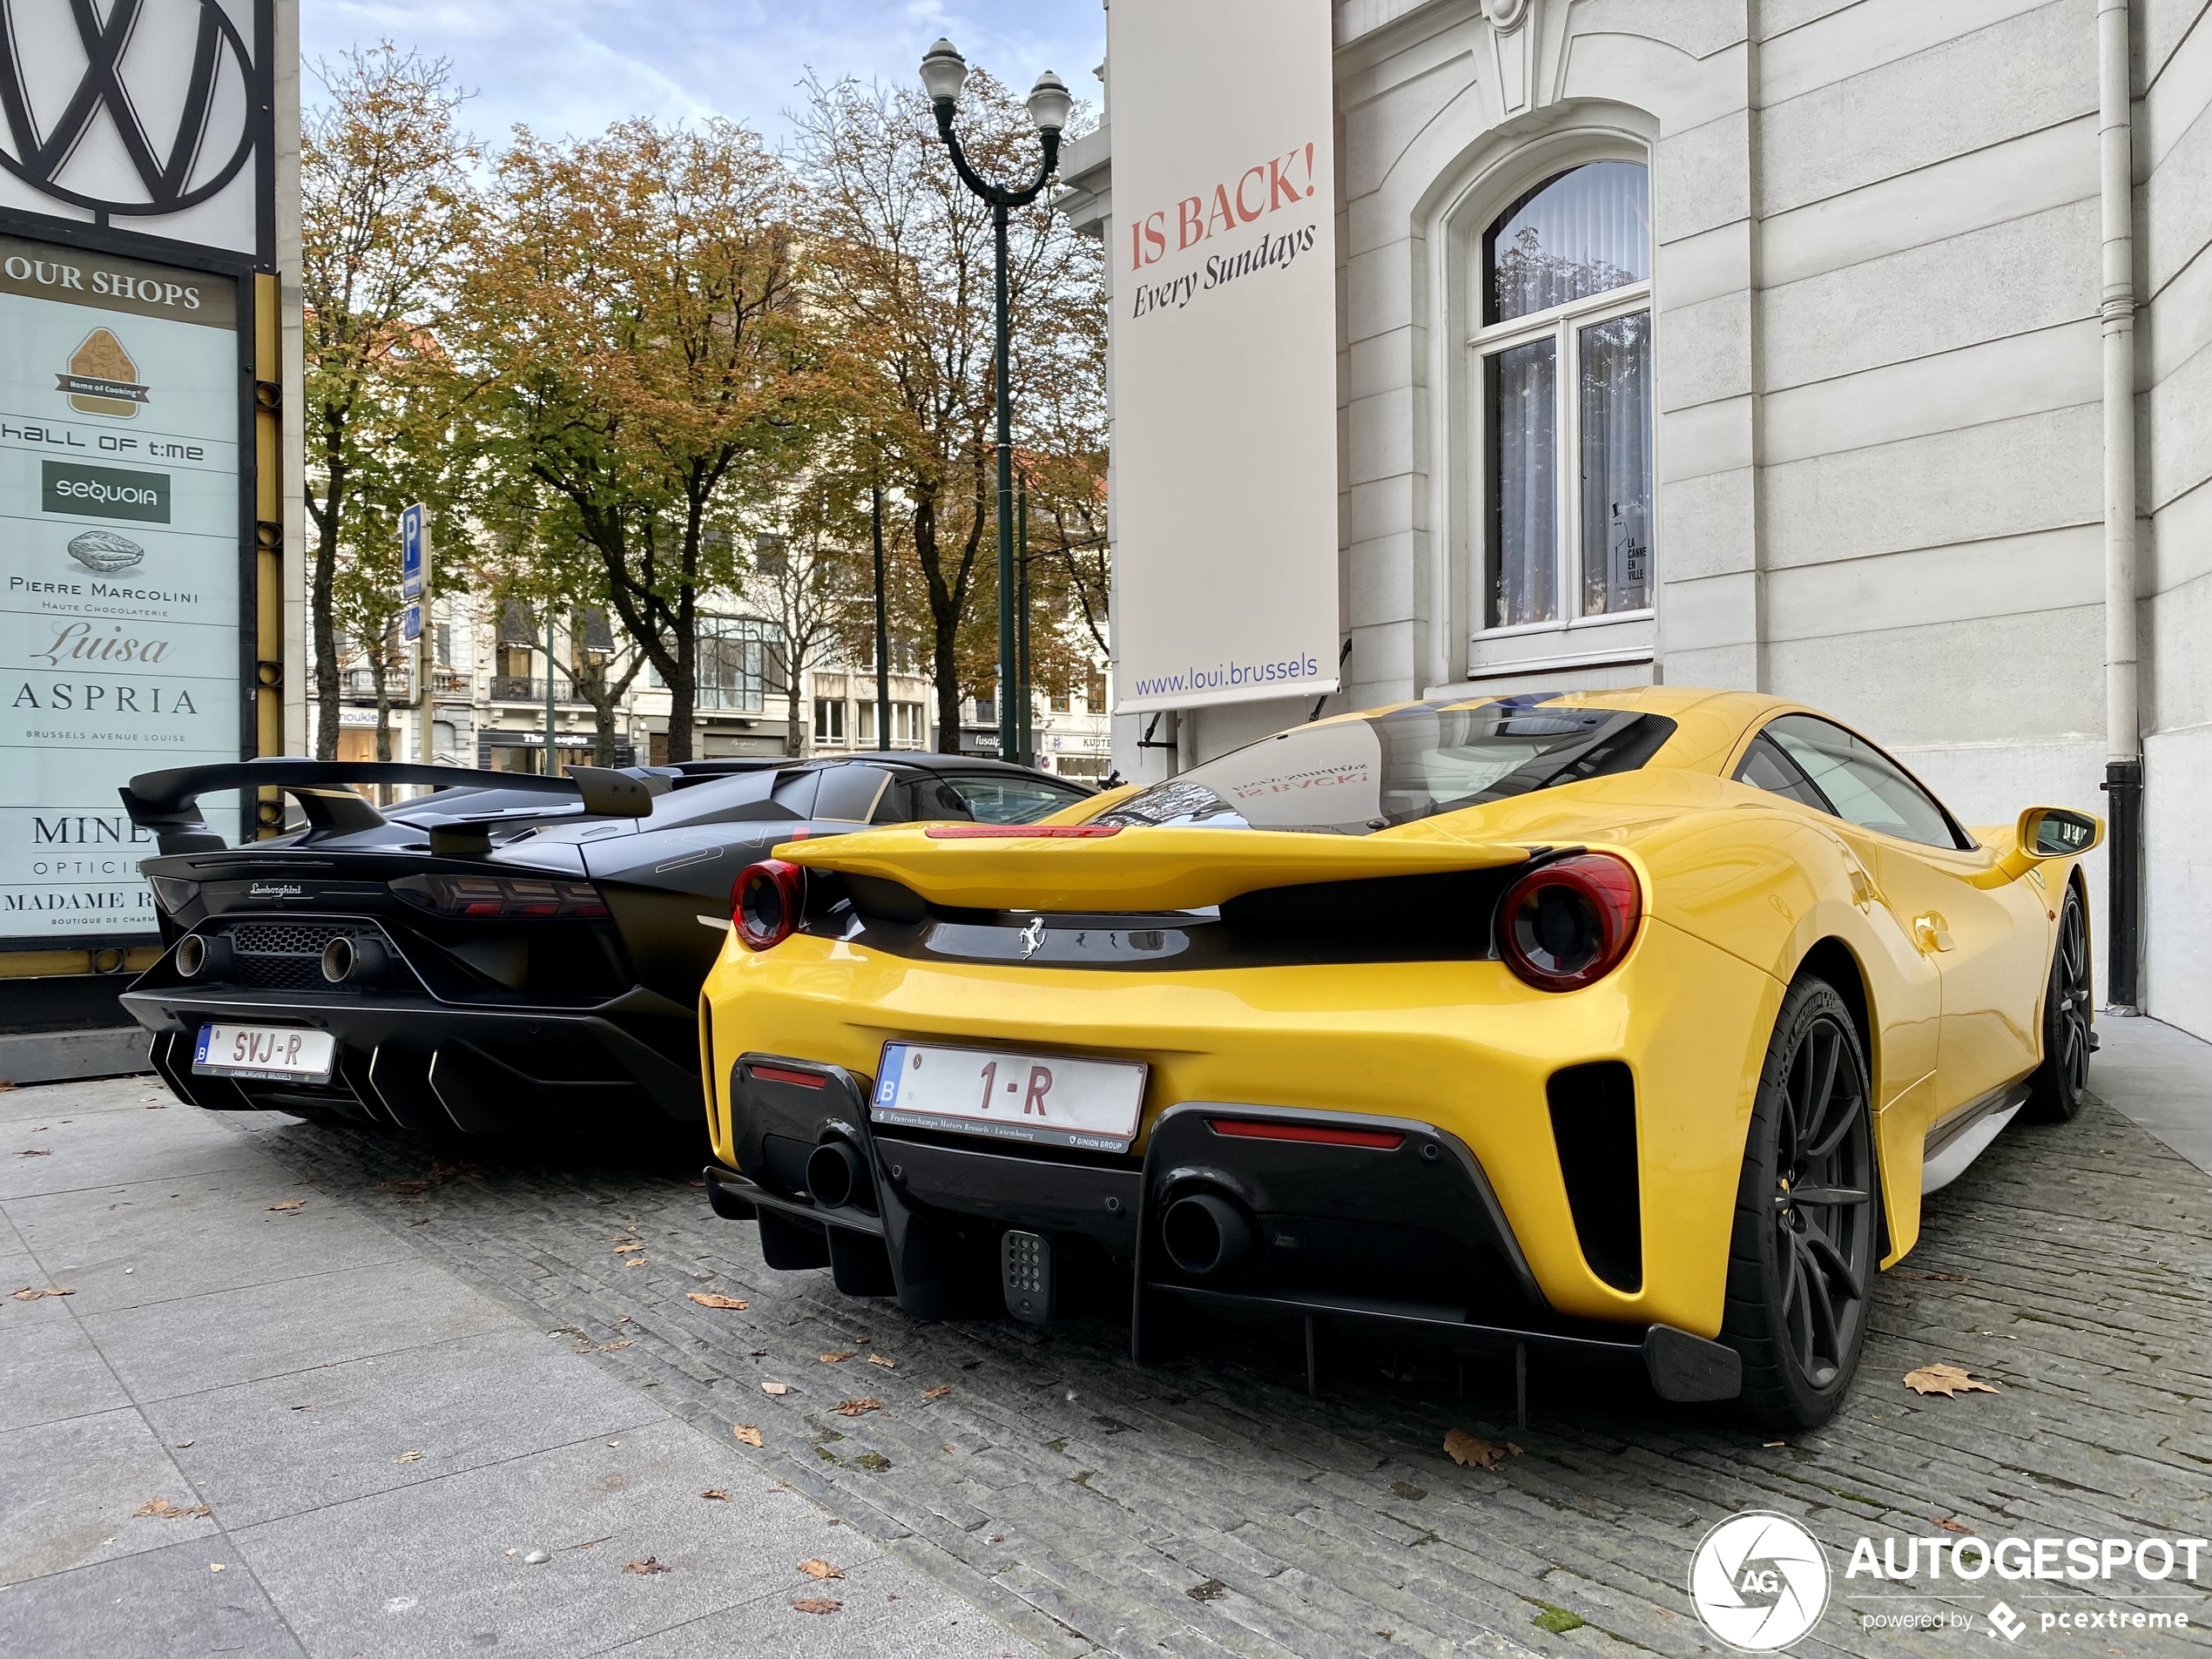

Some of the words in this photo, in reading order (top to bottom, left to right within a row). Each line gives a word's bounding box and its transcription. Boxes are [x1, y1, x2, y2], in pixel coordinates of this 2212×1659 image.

[1130, 211, 1166, 272] IS
[1177, 142, 1314, 252] BACK!
[1132, 271, 1197, 319] Every
[1204, 224, 1316, 289] Sundays
[4, 256, 84, 290] OUR
[91, 271, 200, 309] SHOPS
[70, 381, 93, 391] Home
[406, 513, 417, 562] P
[1628, 537, 1635, 548] LA
[1628, 547, 1647, 559] CANNE
[1628, 560, 1635, 570] EN
[1628, 570, 1643, 581] VILLE
[10, 577, 82, 595] PIERRE
[91, 583, 199, 604] MARCOLINI
[42, 601, 80, 611] HAUTE
[84, 604, 168, 617] CHOCOLATERIE
[30, 622, 177, 666] Luisa
[1136, 651, 1318, 695] www.loui.brussels
[11, 682, 199, 714] ASPRIA
[26, 730, 85, 739] BRUSSELS
[91, 732, 138, 741] AVENUE
[523, 733, 544, 743] The
[554, 736, 588, 745] ooples
[250, 883, 302, 897] Lamborghini
[3, 892, 125, 911] MADAME
[198, 1047, 206, 1061] B
[233, 1031, 302, 1065] SVJ-R
[880, 1080, 894, 1103] B
[981, 1061, 1052, 1116] 1-R
[890, 1113, 938, 1128] Francorchamps
[940, 1119, 962, 1130] Motors
[964, 1123, 989, 1133] Brussels
[995, 1126, 1035, 1141] Luxembourg
[1076, 1136, 1099, 1148] GINION
[1100, 1139, 1122, 1150] GROUP
